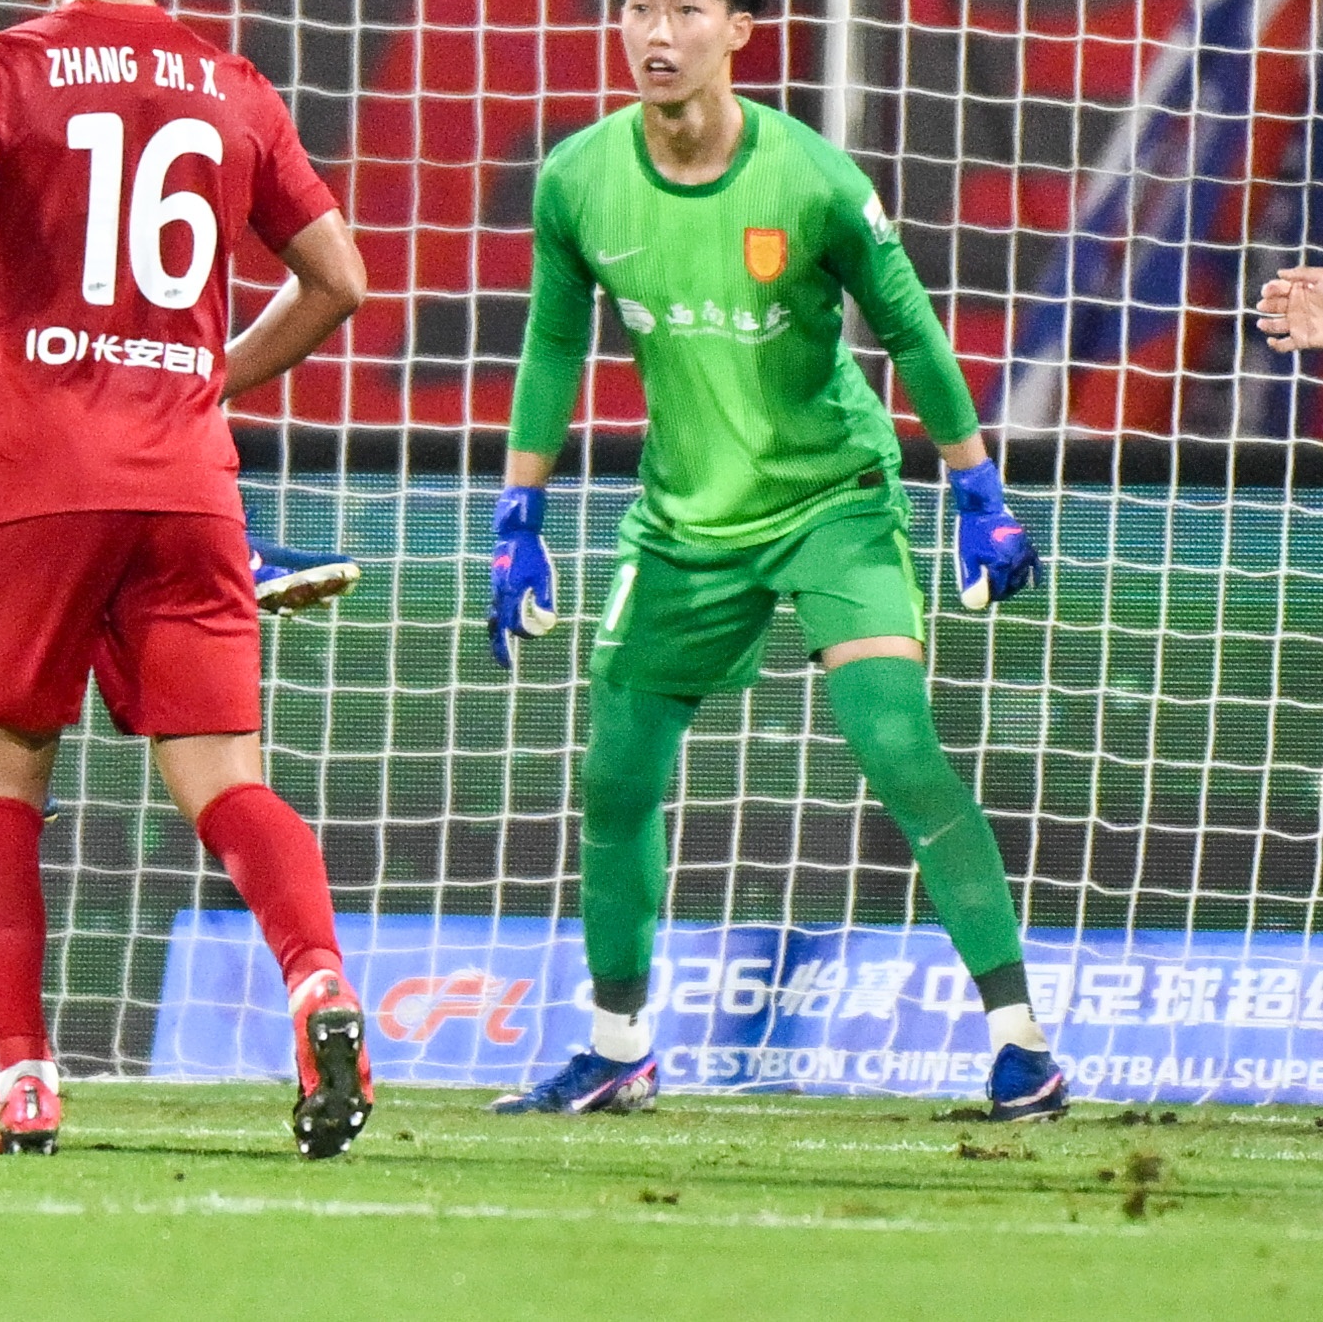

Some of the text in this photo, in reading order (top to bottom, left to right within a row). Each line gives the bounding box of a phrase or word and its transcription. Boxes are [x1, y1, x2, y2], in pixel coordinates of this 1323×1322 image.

[47, 46, 138, 88] ZHANG
[66, 112, 224, 310] 16
[856, 1049, 994, 1083] CHINES
